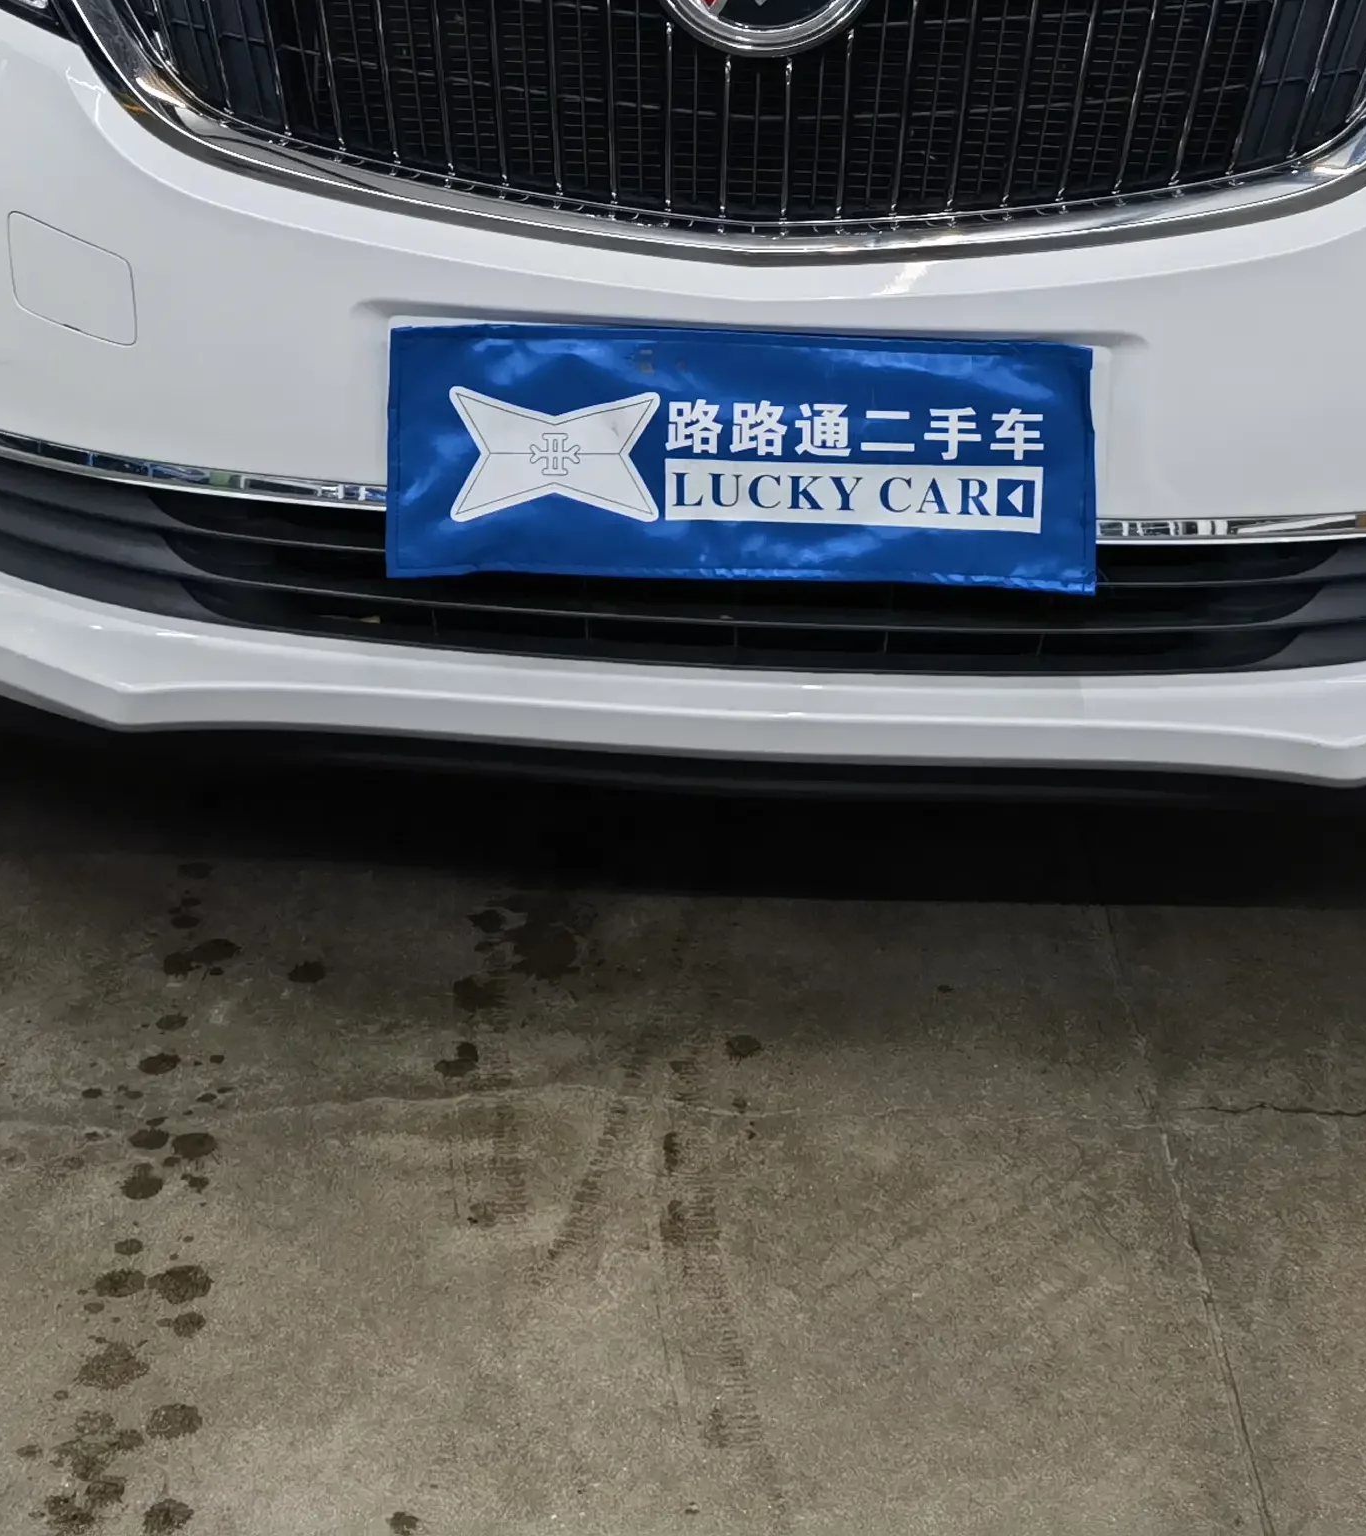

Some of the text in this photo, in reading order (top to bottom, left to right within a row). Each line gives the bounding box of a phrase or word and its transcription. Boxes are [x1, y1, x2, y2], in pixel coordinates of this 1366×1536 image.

[665, 399, 1045, 461] 路路通二手车
[671, 471, 992, 517] LUCKY CAR
